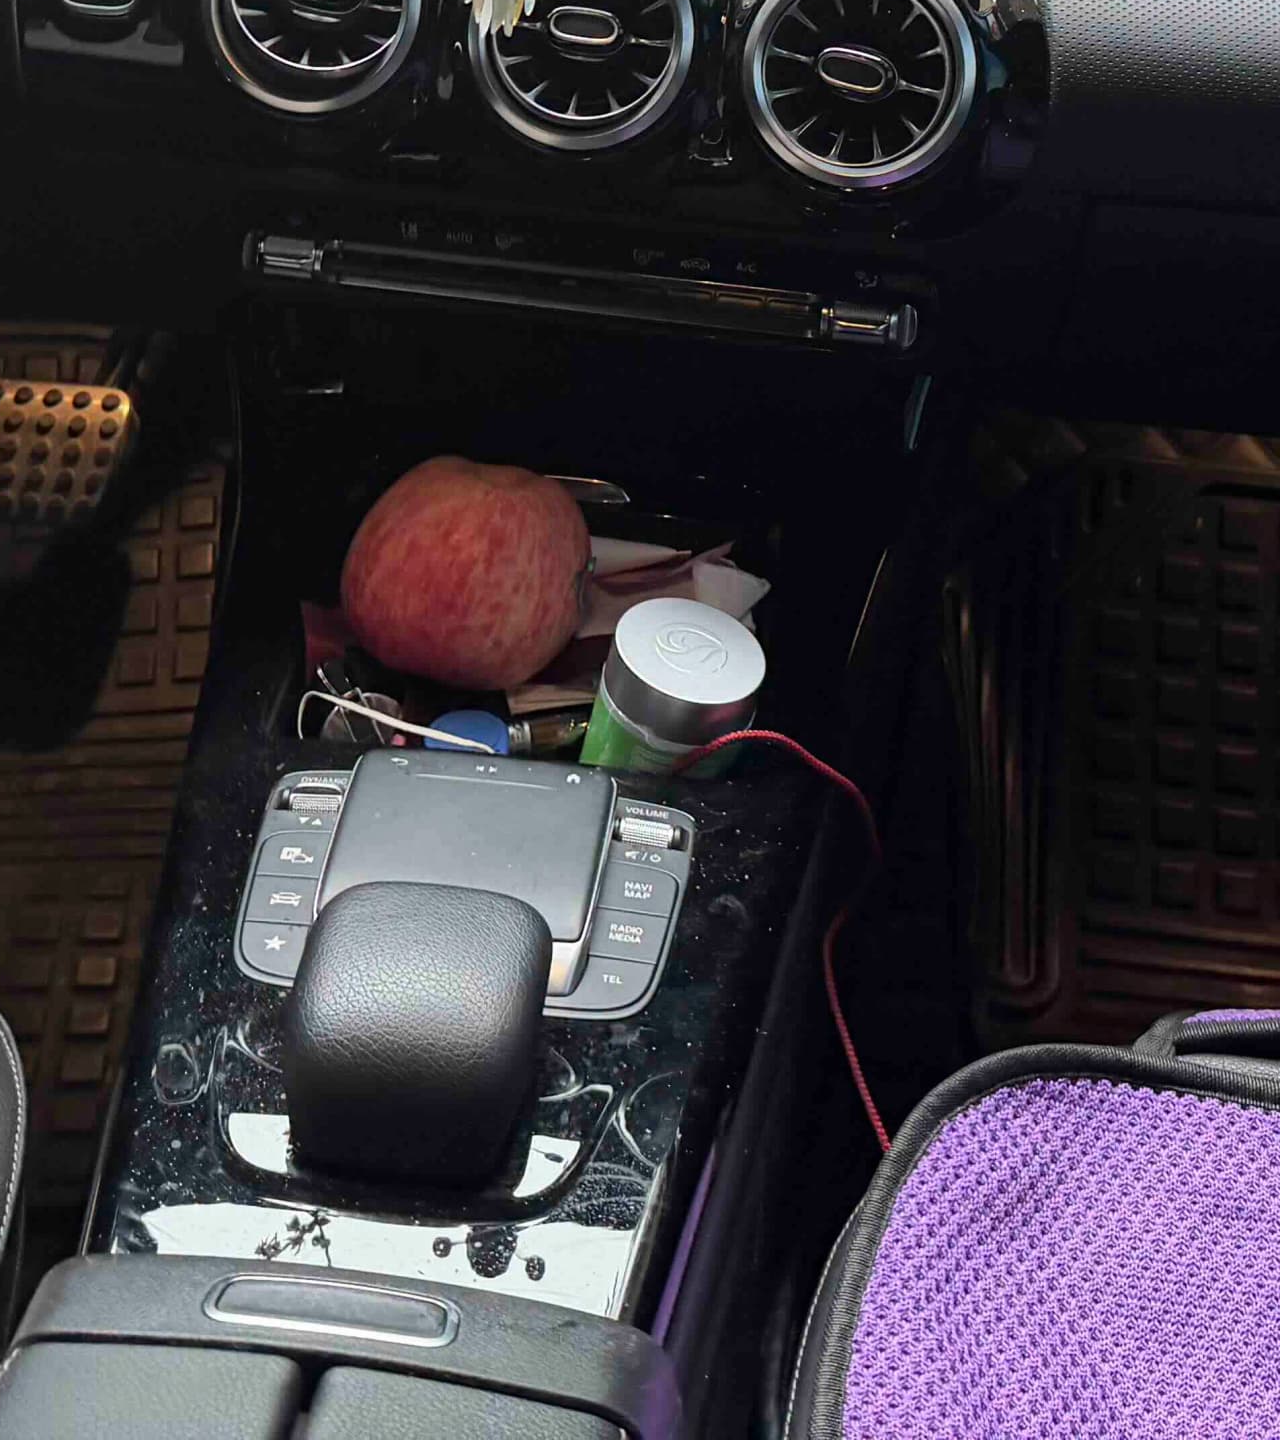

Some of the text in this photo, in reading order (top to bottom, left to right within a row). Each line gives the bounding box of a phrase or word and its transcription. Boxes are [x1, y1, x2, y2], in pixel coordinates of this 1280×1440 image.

[624, 806, 670, 819] VOLUME
[624, 881, 653, 892] NAVI
[624, 890, 651, 899] MAP
[610, 923, 643, 936] RADIO
[608, 933, 641, 944] MEDIA
[602, 974, 622, 984] TEL
